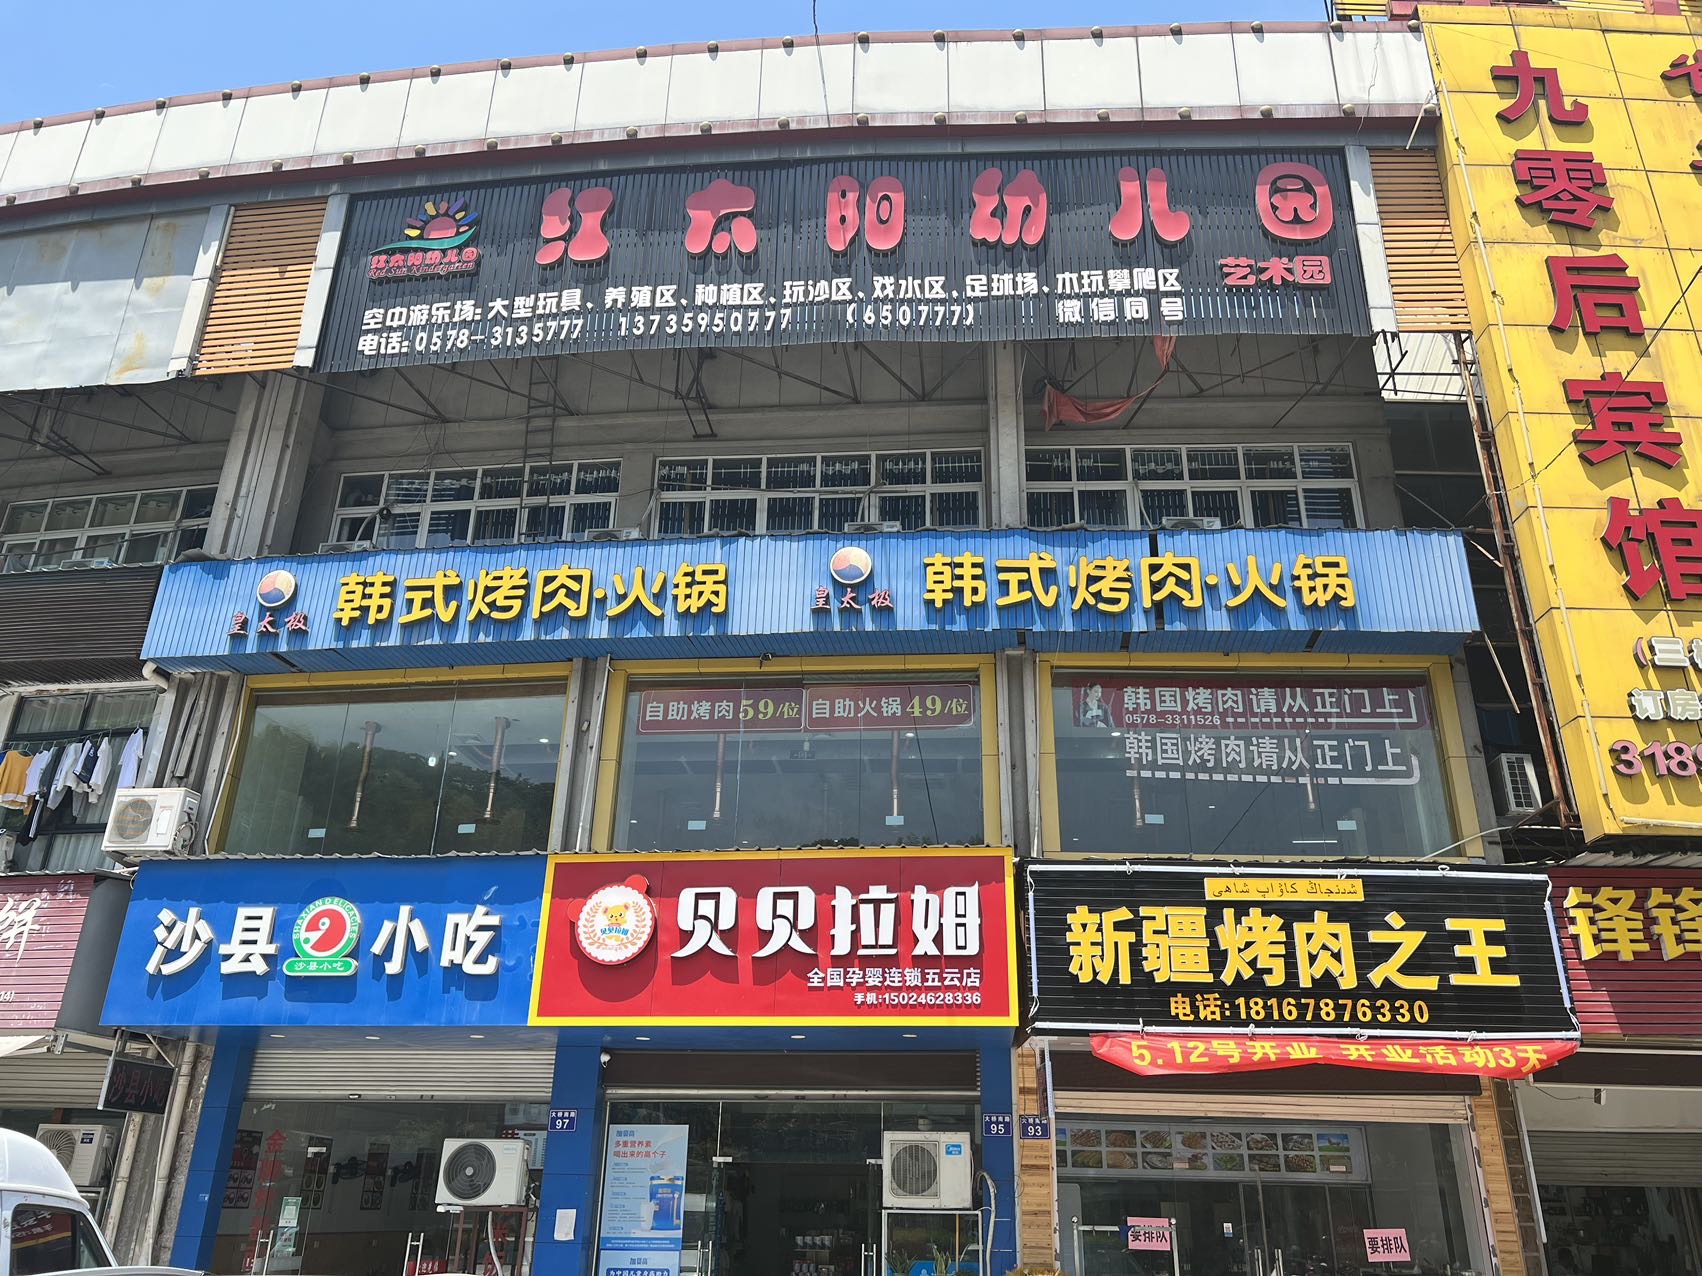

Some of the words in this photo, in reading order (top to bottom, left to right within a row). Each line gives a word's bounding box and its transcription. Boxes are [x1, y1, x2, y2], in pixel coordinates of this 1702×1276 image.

[1219, 255, 1331, 285] 艺术园
[619, 308, 792, 336] 13735950777
[846, 303, 974, 325] (650777)
[1057, 297, 1184, 323] 微信同号
[1489, 50, 1702, 601] 九零后宾馆
[332, 563, 727, 626] 韩式烤肉·火锅
[811, 585, 894, 608] 皇太极
[923, 552, 1355, 612] 韩式烤肉·火锅
[228, 611, 309, 635] 皇太极
[1123, 686, 1404, 713] 韩国烤肉请从正门上
[1125, 713, 1221, 726] 0578-3311526
[1124, 731, 1408, 772] 韩国烤肉请从正门上
[293, 900, 322, 939] SHAXIAN
[325, 898, 359, 939] DELICACIES
[670, 880, 982, 958] 贝贝拉姆
[146, 906, 284, 977] 沙县
[370, 905, 502, 976] 小吃
[1066, 905, 1521, 990] 新疆烤肉之王
[294, 961, 345, 971] 沙县小吃
[807, 967, 981, 987] 全国孕婴连锁五云店
[854, 993, 981, 1005] 手机:15024628336
[1170, 993, 1430, 1024] 电话:18167876330
[1131, 1040, 1323, 1066] 5.12号开业
[1340, 1043, 1548, 1073] 开业活动3天
[555, 1119, 569, 1129] 97
[990, 1123, 1005, 1134] 95
[1027, 1125, 1042, 1136] 93
[1366, 1236, 1407, 1255] 要排队
